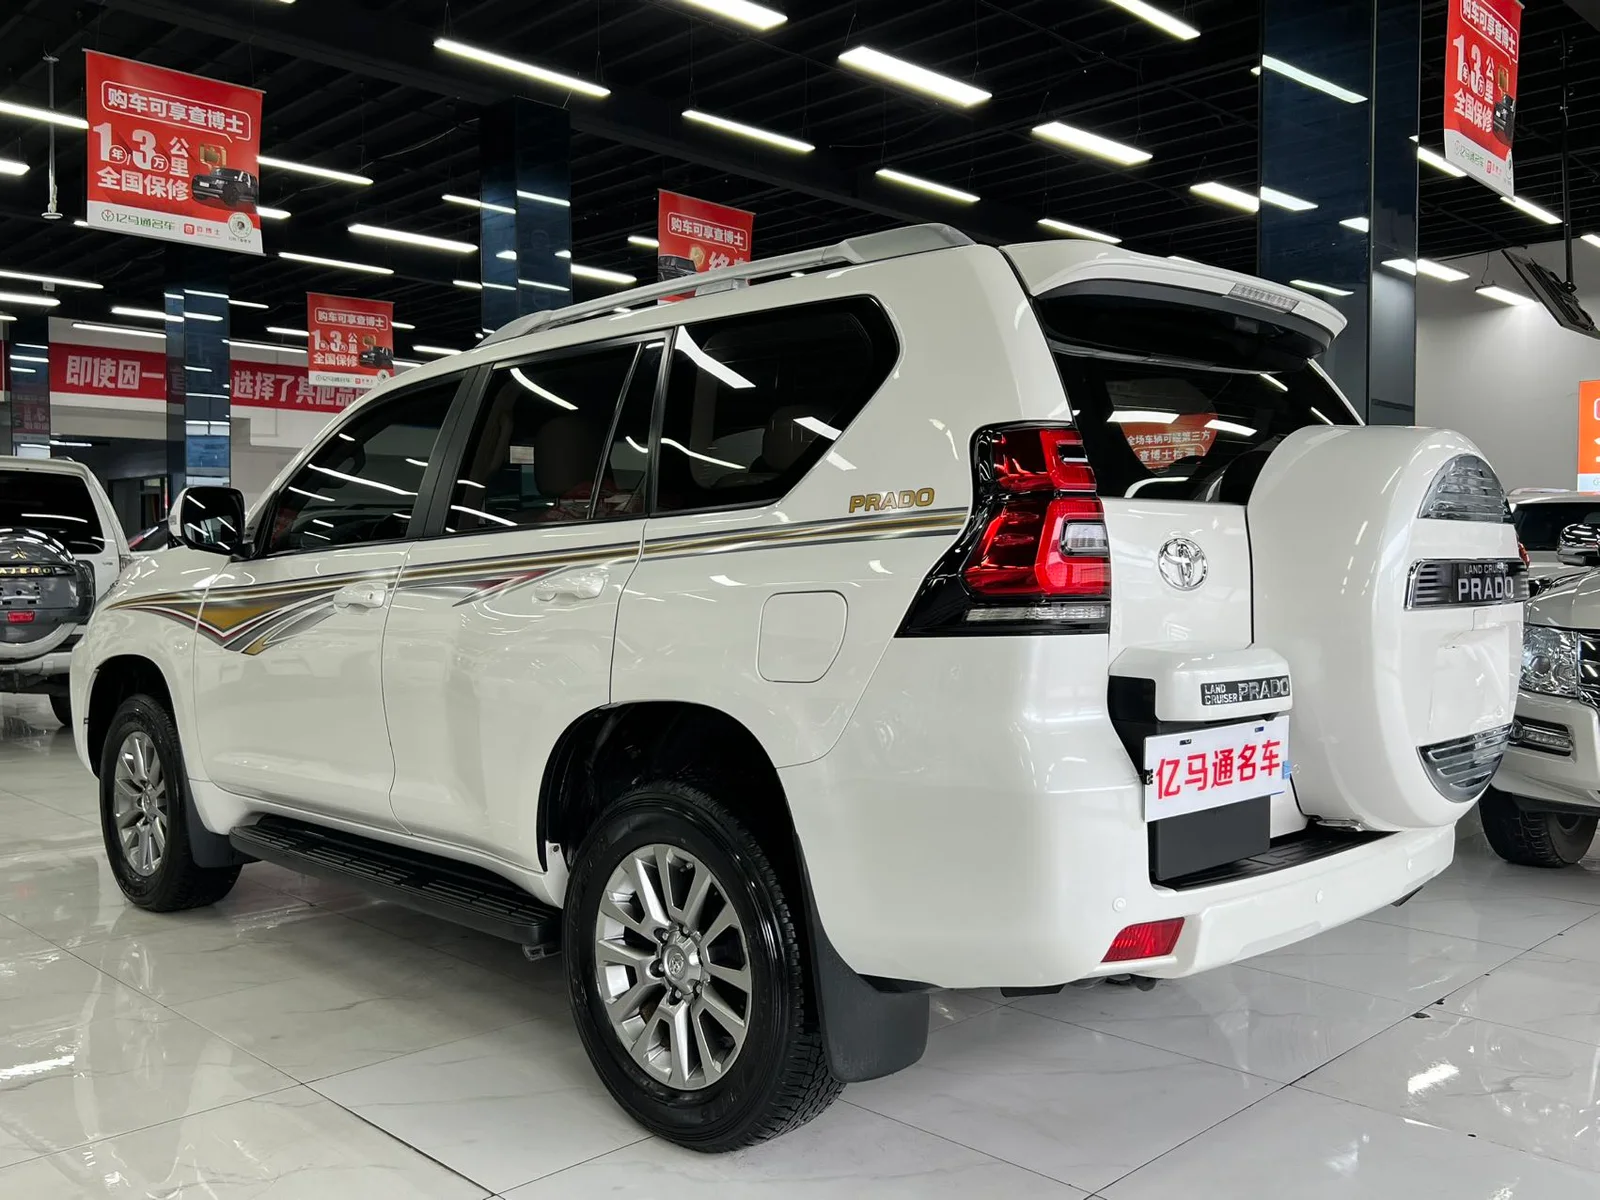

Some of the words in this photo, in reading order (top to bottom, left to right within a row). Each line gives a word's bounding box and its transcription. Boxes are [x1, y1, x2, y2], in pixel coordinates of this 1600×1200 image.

[107, 87, 244, 135] 购车可享查博士
[1453, 88, 1494, 133] 全国保修
[97, 166, 190, 202] 全国保修
[671, 217, 744, 247] 购车可享查博士
[313, 352, 358, 367] 全国保修
[233, 370, 366, 407] 选择了其他品
[849, 487, 935, 513] PRADO
[1463, 564, 1483, 575] LAND
[1457, 576, 1514, 602] PRADO
[1204, 684, 1226, 695] LAND
[1237, 677, 1290, 702] PRADO
[1204, 693, 1238, 705] CRUISER
[1155, 739, 1281, 800] 亿马通名车
